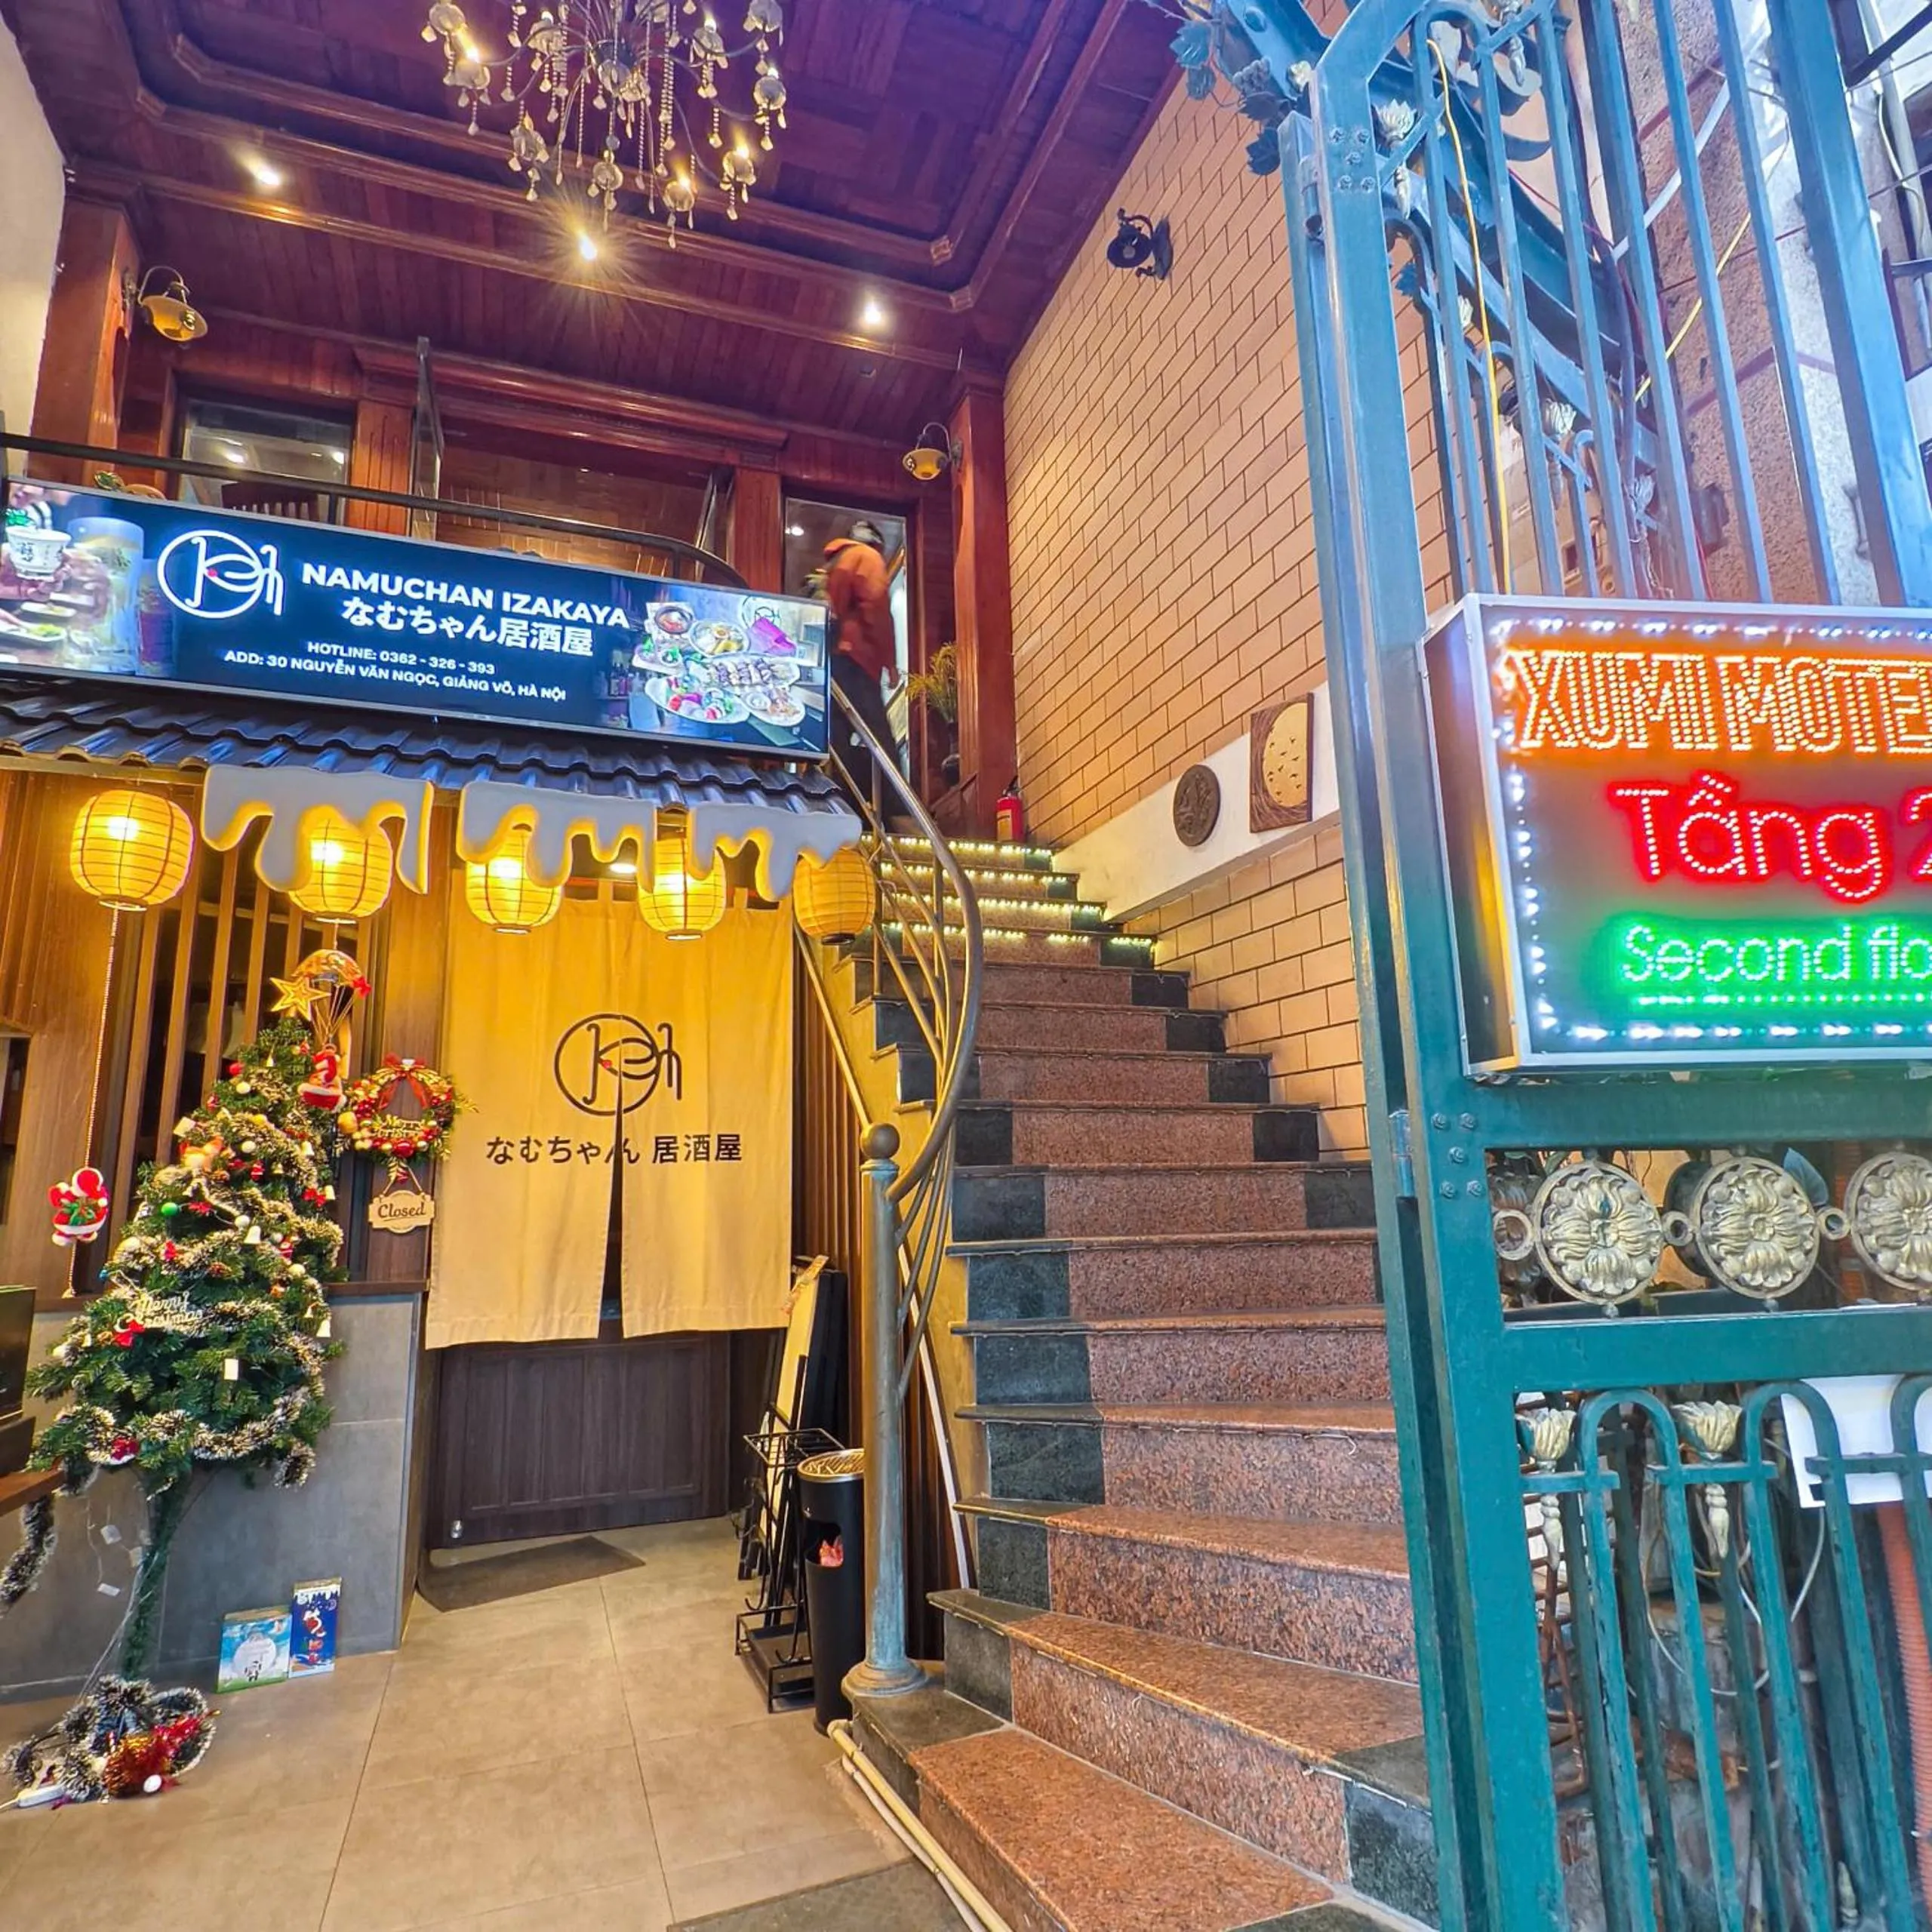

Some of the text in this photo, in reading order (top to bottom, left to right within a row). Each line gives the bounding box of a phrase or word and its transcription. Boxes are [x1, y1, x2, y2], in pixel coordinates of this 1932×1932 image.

[302, 562, 630, 629] NAMUCHAN IZAKAYA
[341, 596, 593, 657] なむちゃん居酒屋
[224, 650, 567, 702] ADD: 30 NGUYỄN VĂN NGỌC, GIẢNG VÕ, HÀ NỘI
[307, 641, 377, 660] HOTLINE:
[380, 651, 417, 666] 0362
[429, 657, 456, 670] 326
[467, 661, 495, 675] 393
[1507, 650, 1932, 753] XUMI MOTE
[1615, 774, 1882, 899] Tầng
[1623, 924, 1851, 983] Second
[377, 1201, 426, 1219] Closed
